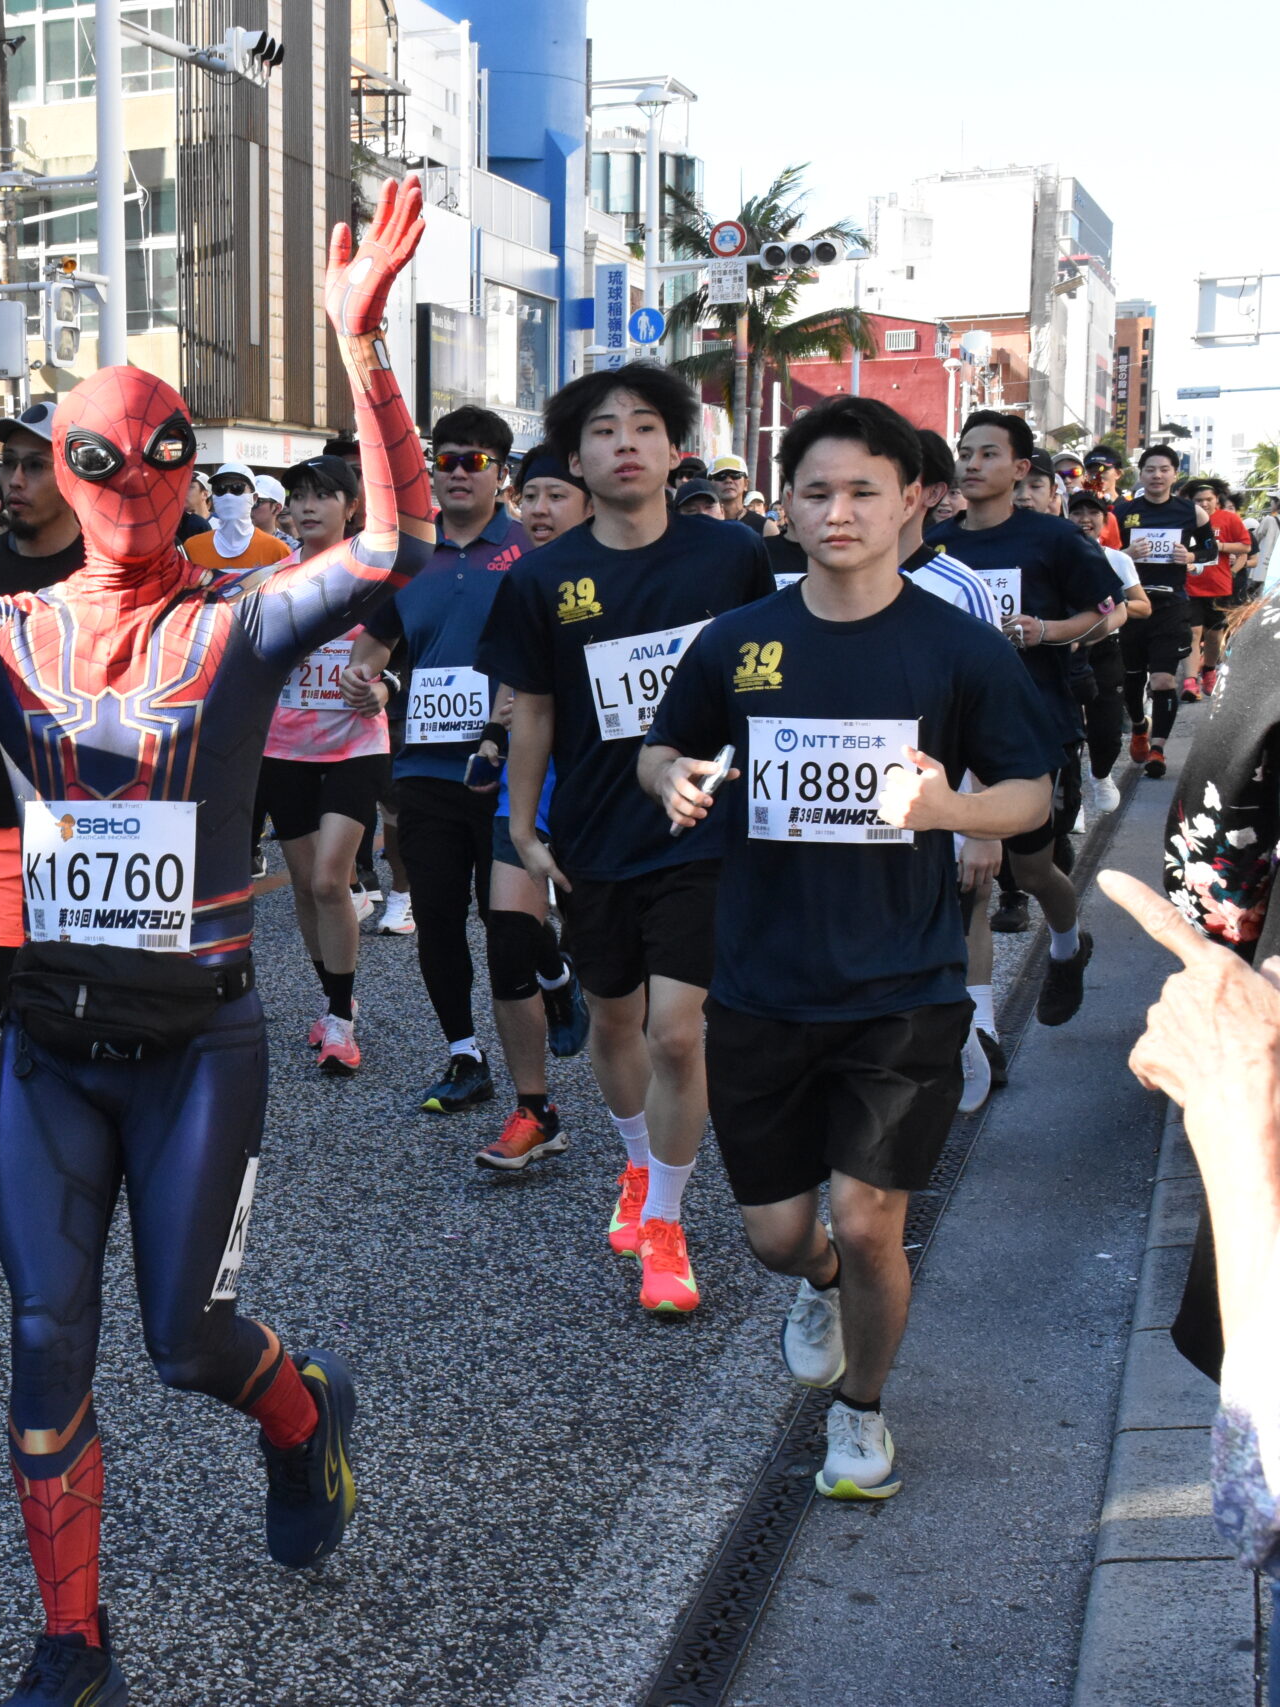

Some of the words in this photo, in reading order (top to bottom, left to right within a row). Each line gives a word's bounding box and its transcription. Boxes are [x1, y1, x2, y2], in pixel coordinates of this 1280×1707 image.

[557, 577, 596, 612] 39
[629, 642, 666, 663] ANA
[736, 640, 783, 675] 39
[299, 663, 350, 688] 214
[420, 676, 443, 688] ANA
[753, 759, 905, 803] K1889
[76, 817, 141, 835] sato
[788, 806, 823, 824] 第39回
[823, 808, 891, 826] NAHAマ
[26, 852, 184, 903] K16760
[58, 907, 92, 929] 第39回
[92, 908, 186, 930] NAHAマラソン
